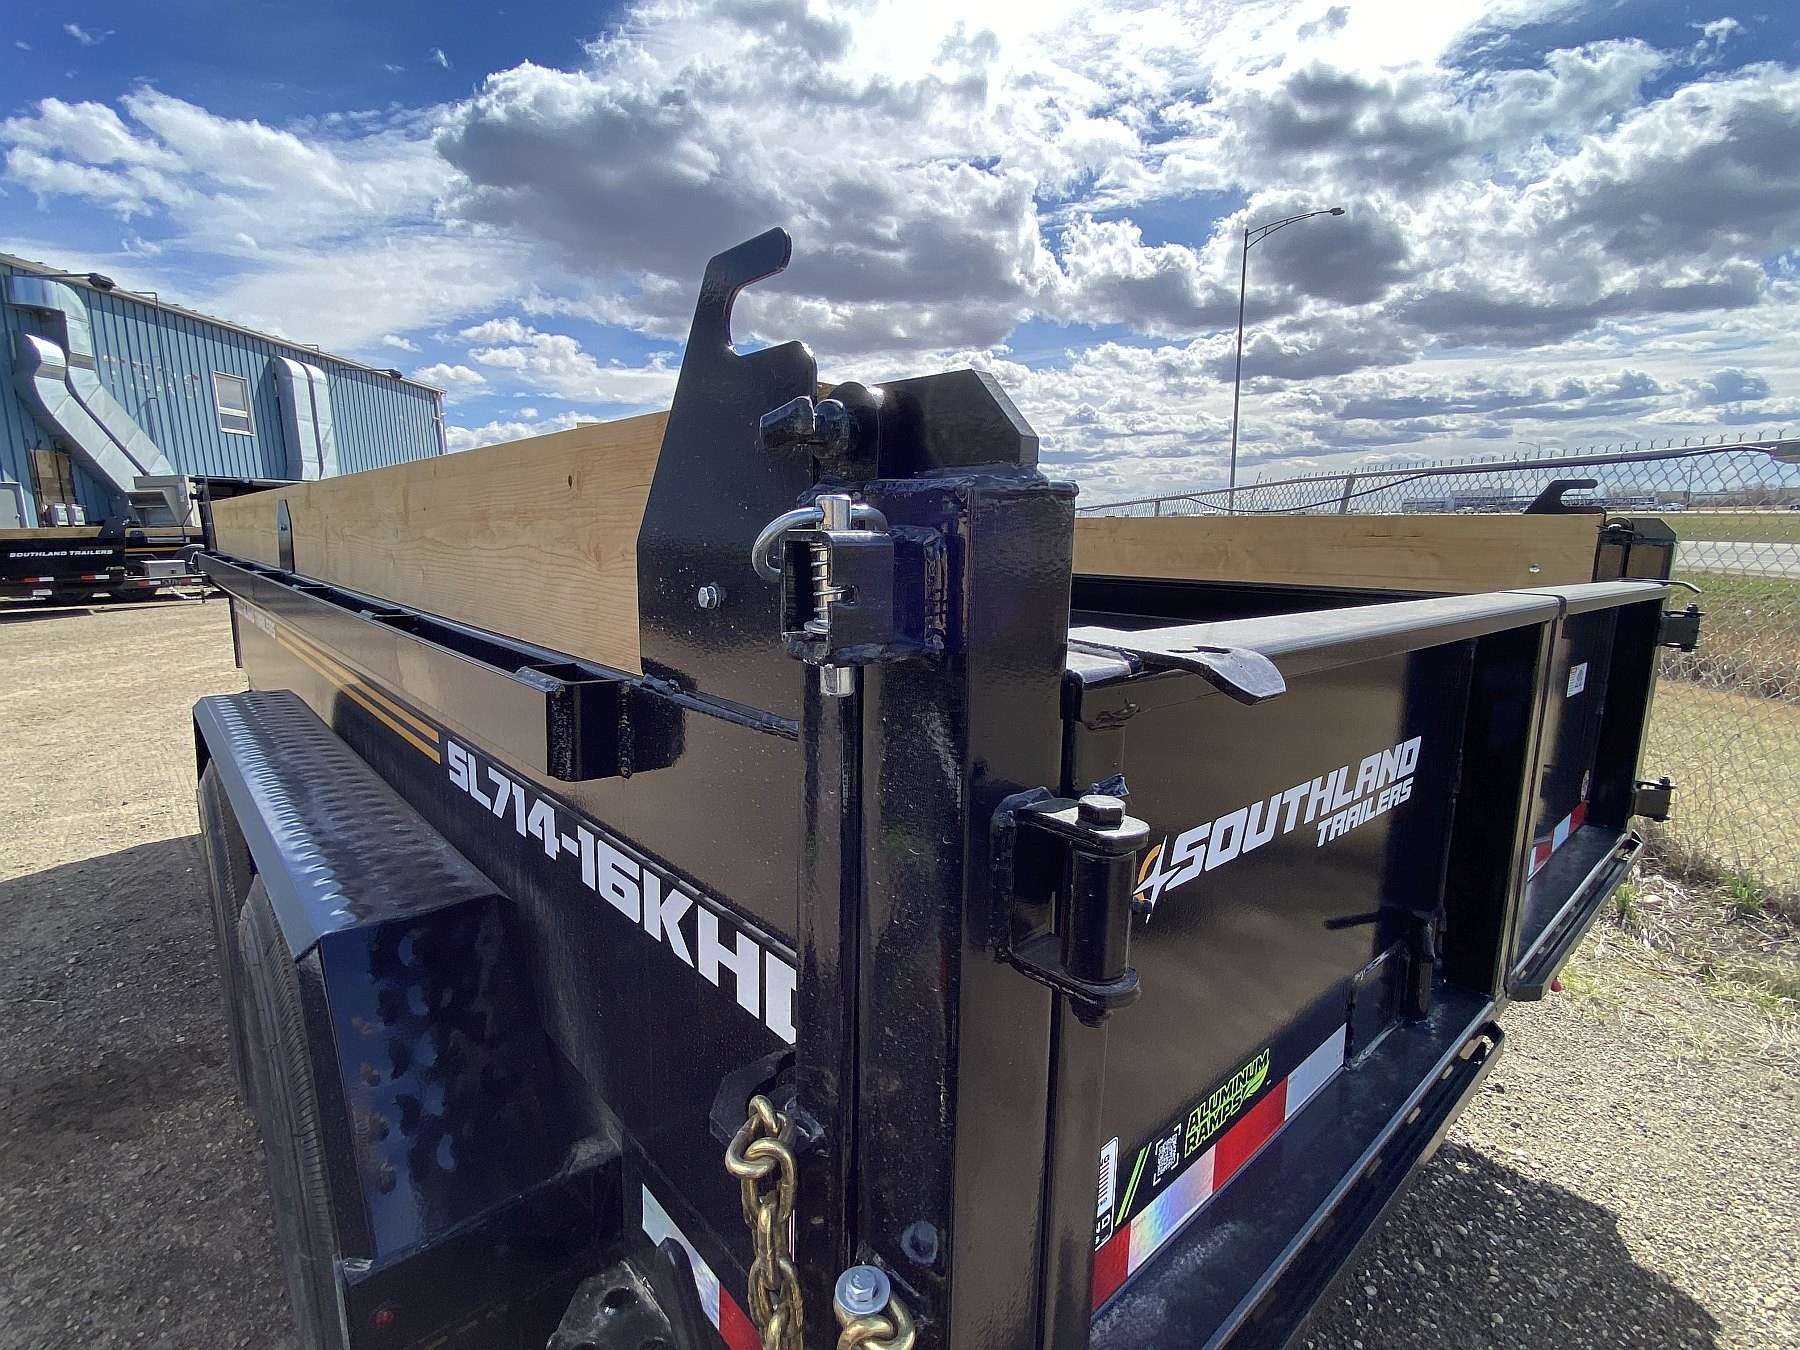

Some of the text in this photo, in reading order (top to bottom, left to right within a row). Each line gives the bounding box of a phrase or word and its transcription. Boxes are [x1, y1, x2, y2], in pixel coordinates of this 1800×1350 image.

[1165, 736, 1422, 891] SOUTHLAND
[1317, 777, 1413, 847] TRAILERS
[1185, 1095, 1244, 1158] RAMPS
[1187, 1048, 1270, 1134] ALUMINUM
